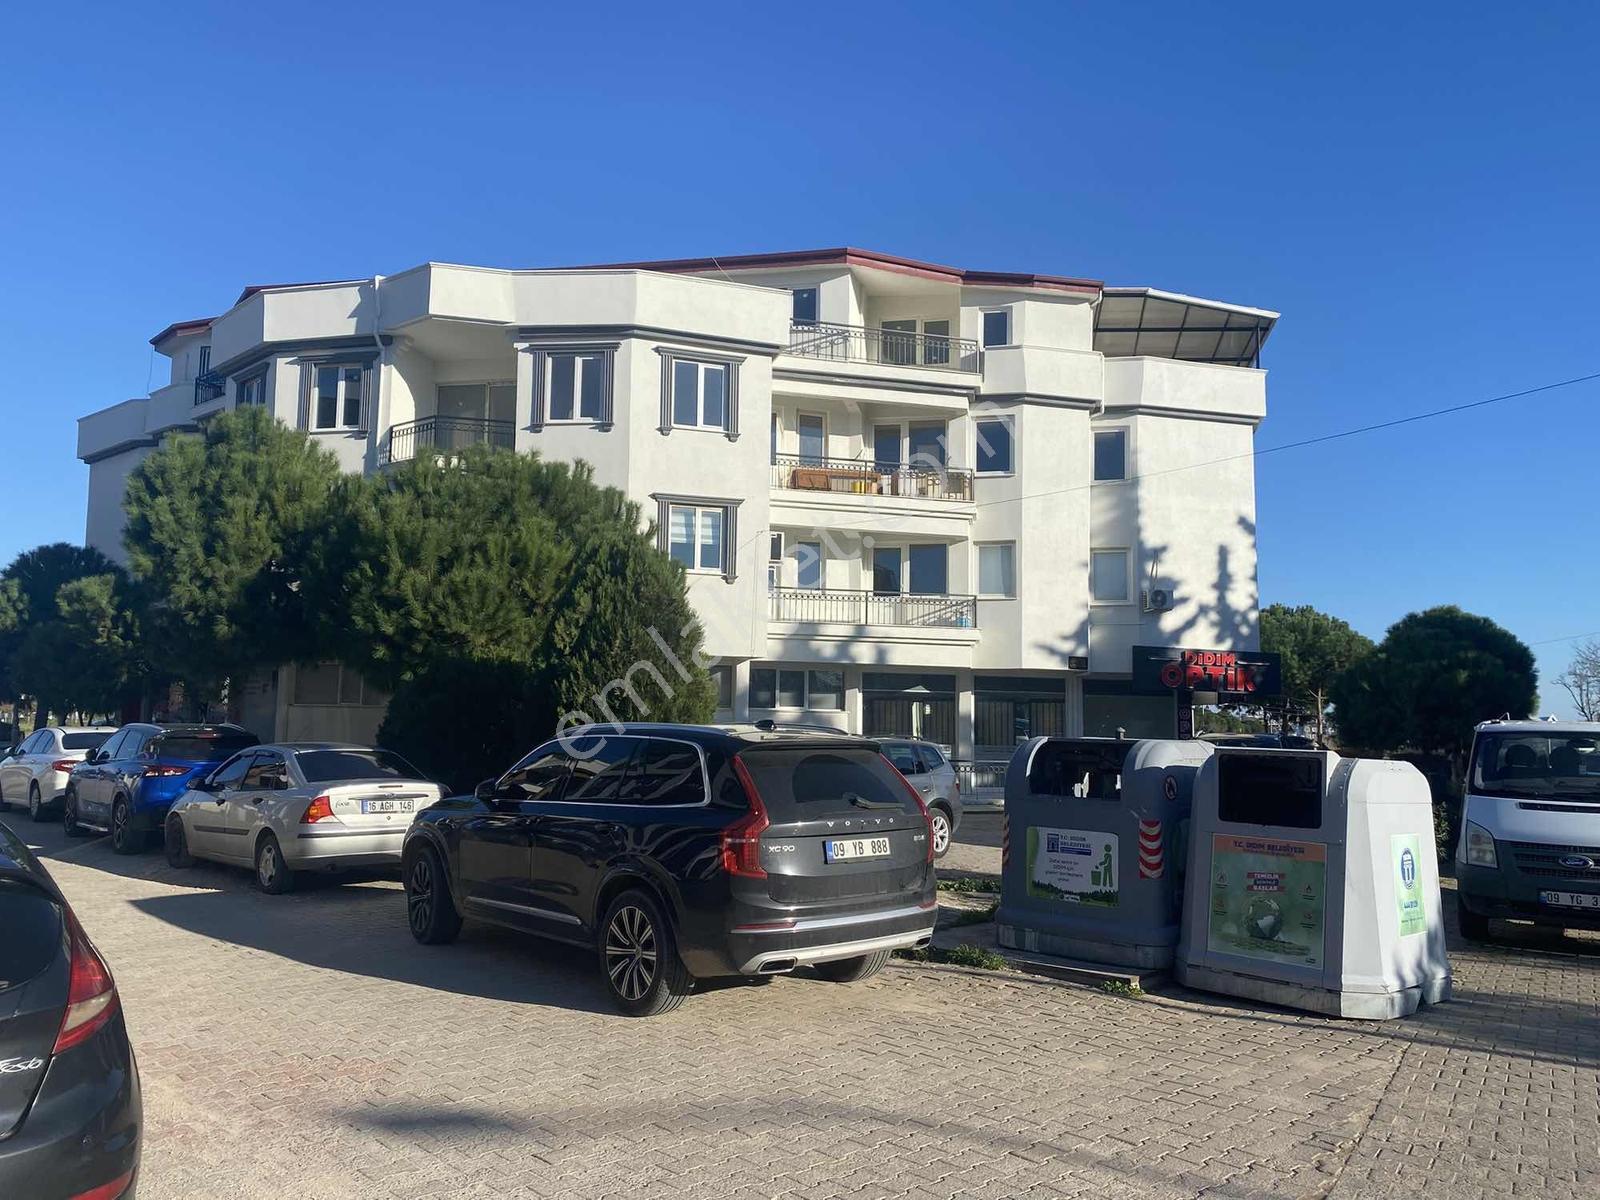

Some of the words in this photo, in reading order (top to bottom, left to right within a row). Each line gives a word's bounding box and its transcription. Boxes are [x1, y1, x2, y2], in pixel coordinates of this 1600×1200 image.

[368, 802, 377, 811] 16
[380, 801, 394, 811] AGH
[399, 801, 412, 810] 146
[833, 842, 846, 857] 09
[852, 840, 864, 855] YB
[870, 839, 888, 855] 888
[1547, 892, 1560, 903] 09
[1591, 896, 1600, 907] 3
